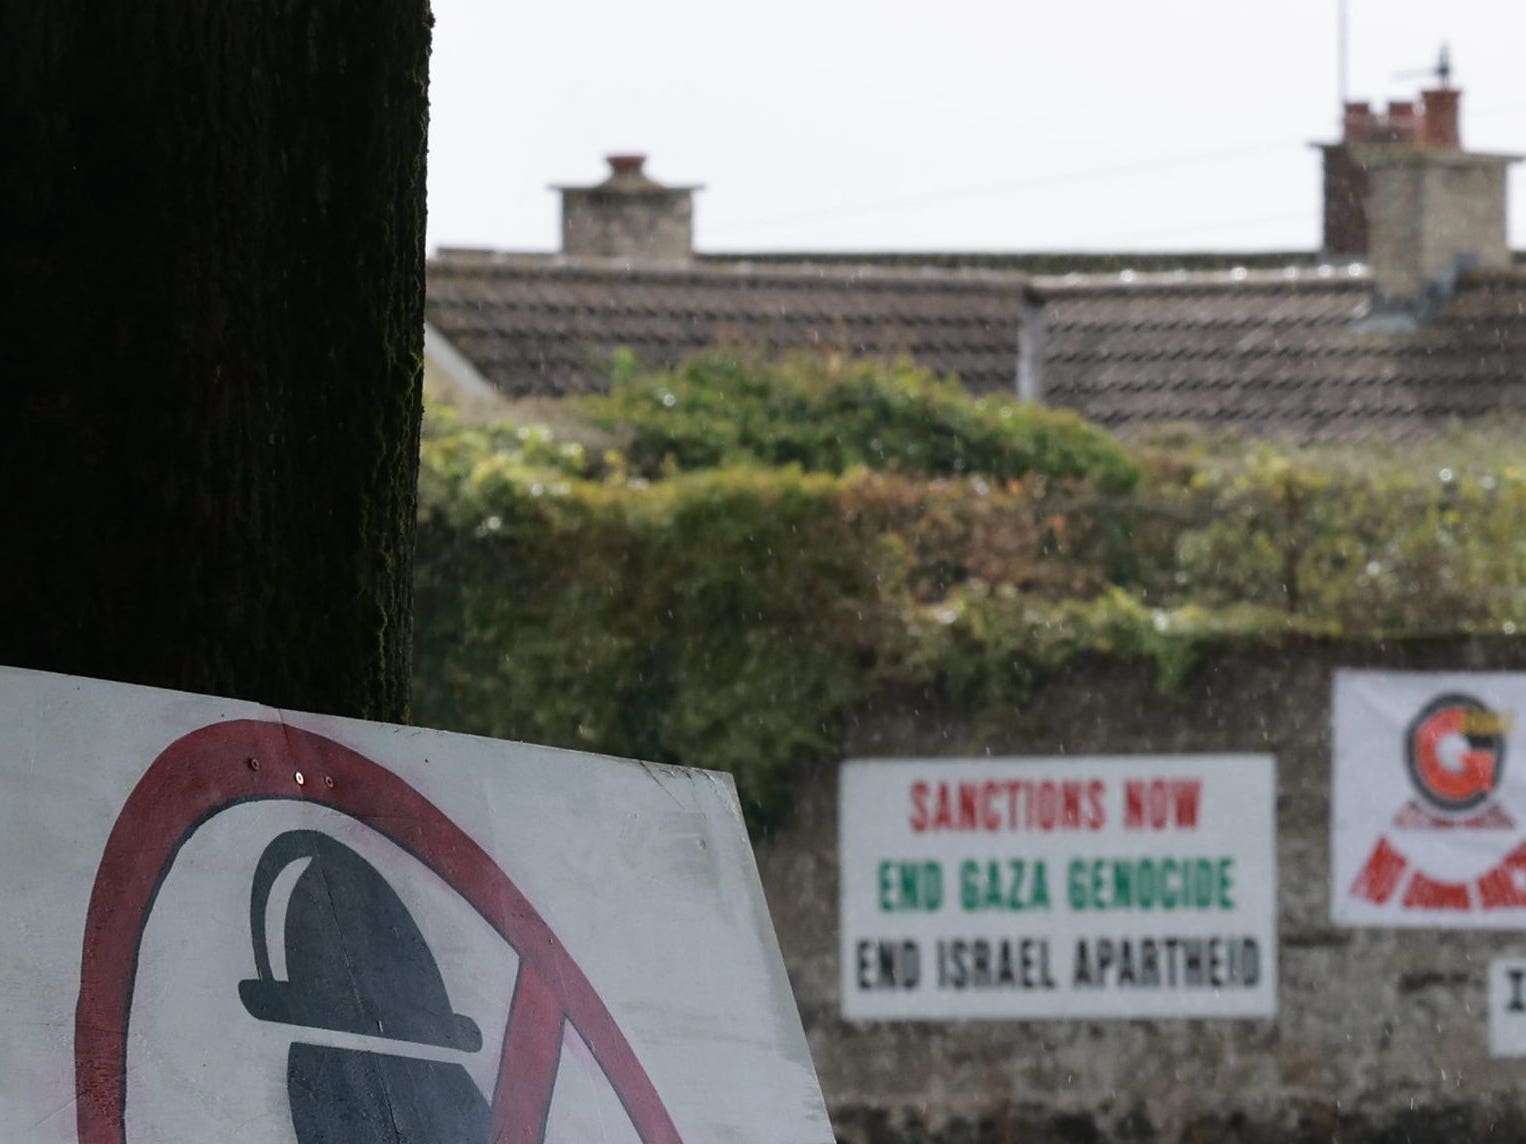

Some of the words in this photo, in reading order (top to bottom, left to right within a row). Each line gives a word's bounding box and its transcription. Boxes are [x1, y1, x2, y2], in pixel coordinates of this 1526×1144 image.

[909, 779, 1106, 832] SANCTIONS
[1123, 778, 1204, 830] NOW
[878, 859, 943, 912] END
[960, 858, 1051, 912] GAZA
[1067, 857, 1236, 911] GENOCIDE
[856, 939, 920, 990] END
[938, 938, 1056, 989] ISRAEL
[1072, 936, 1262, 988] APARTHEID
